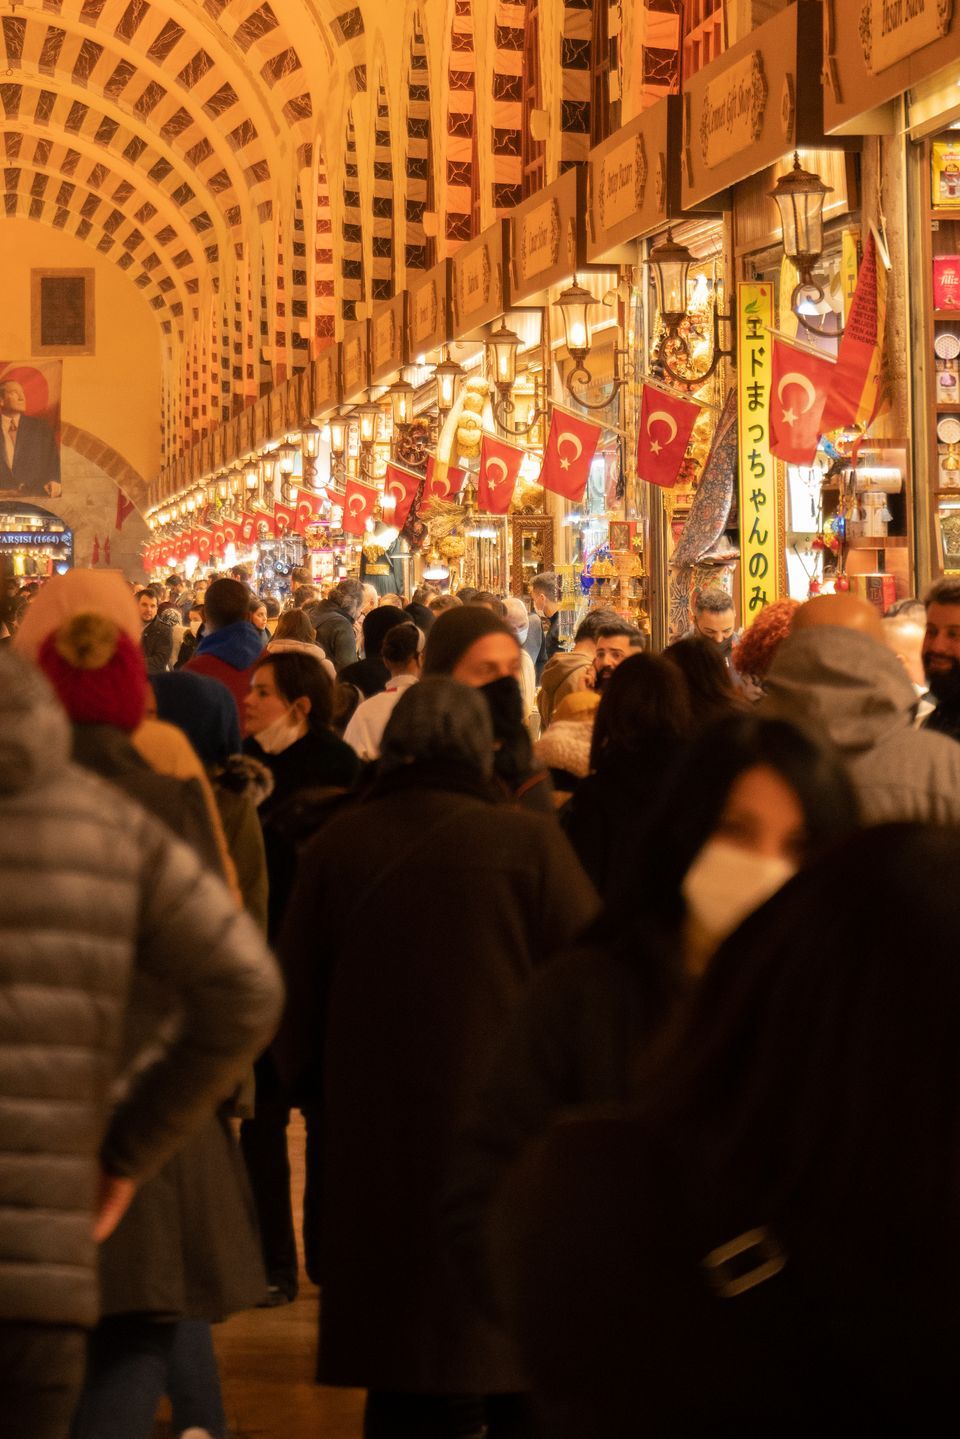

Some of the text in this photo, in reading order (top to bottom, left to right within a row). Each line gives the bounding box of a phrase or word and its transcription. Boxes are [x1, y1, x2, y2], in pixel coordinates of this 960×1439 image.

[726, 83, 737, 135] Gift
[737, 78, 752, 126] Shop
[34, 535, 59, 544] (1664)
